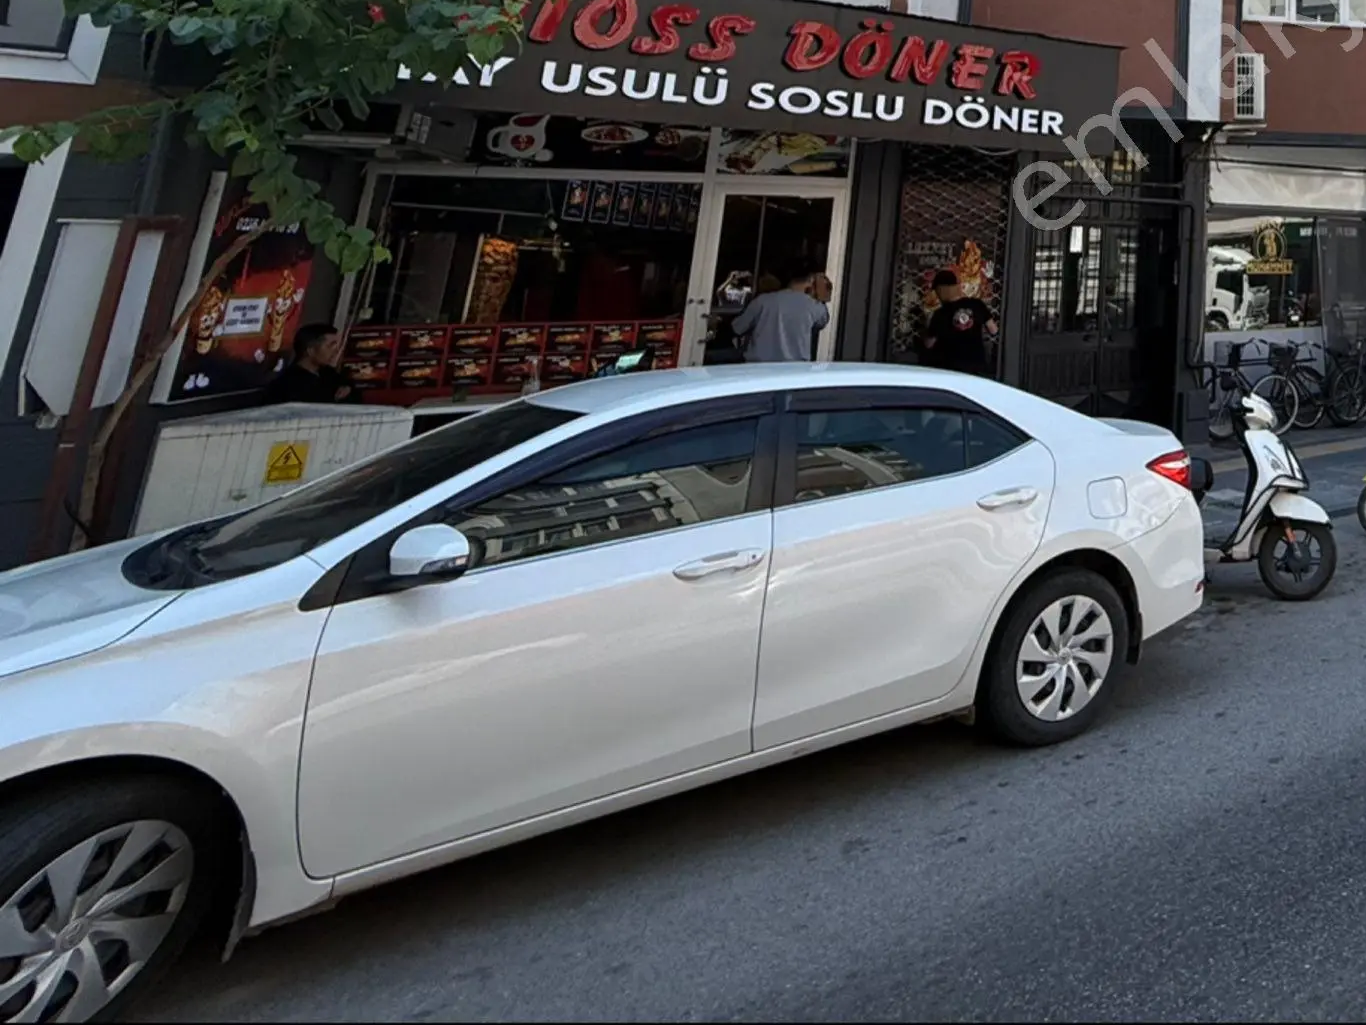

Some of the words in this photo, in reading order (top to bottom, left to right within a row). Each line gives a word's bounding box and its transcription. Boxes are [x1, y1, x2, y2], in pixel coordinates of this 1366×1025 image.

[540, 60, 729, 106] USULÜ
[747, 81, 906, 123] SOSLU
[923, 95, 1065, 136] DÖNER
[785, 19, 1042, 99] DÖNER
